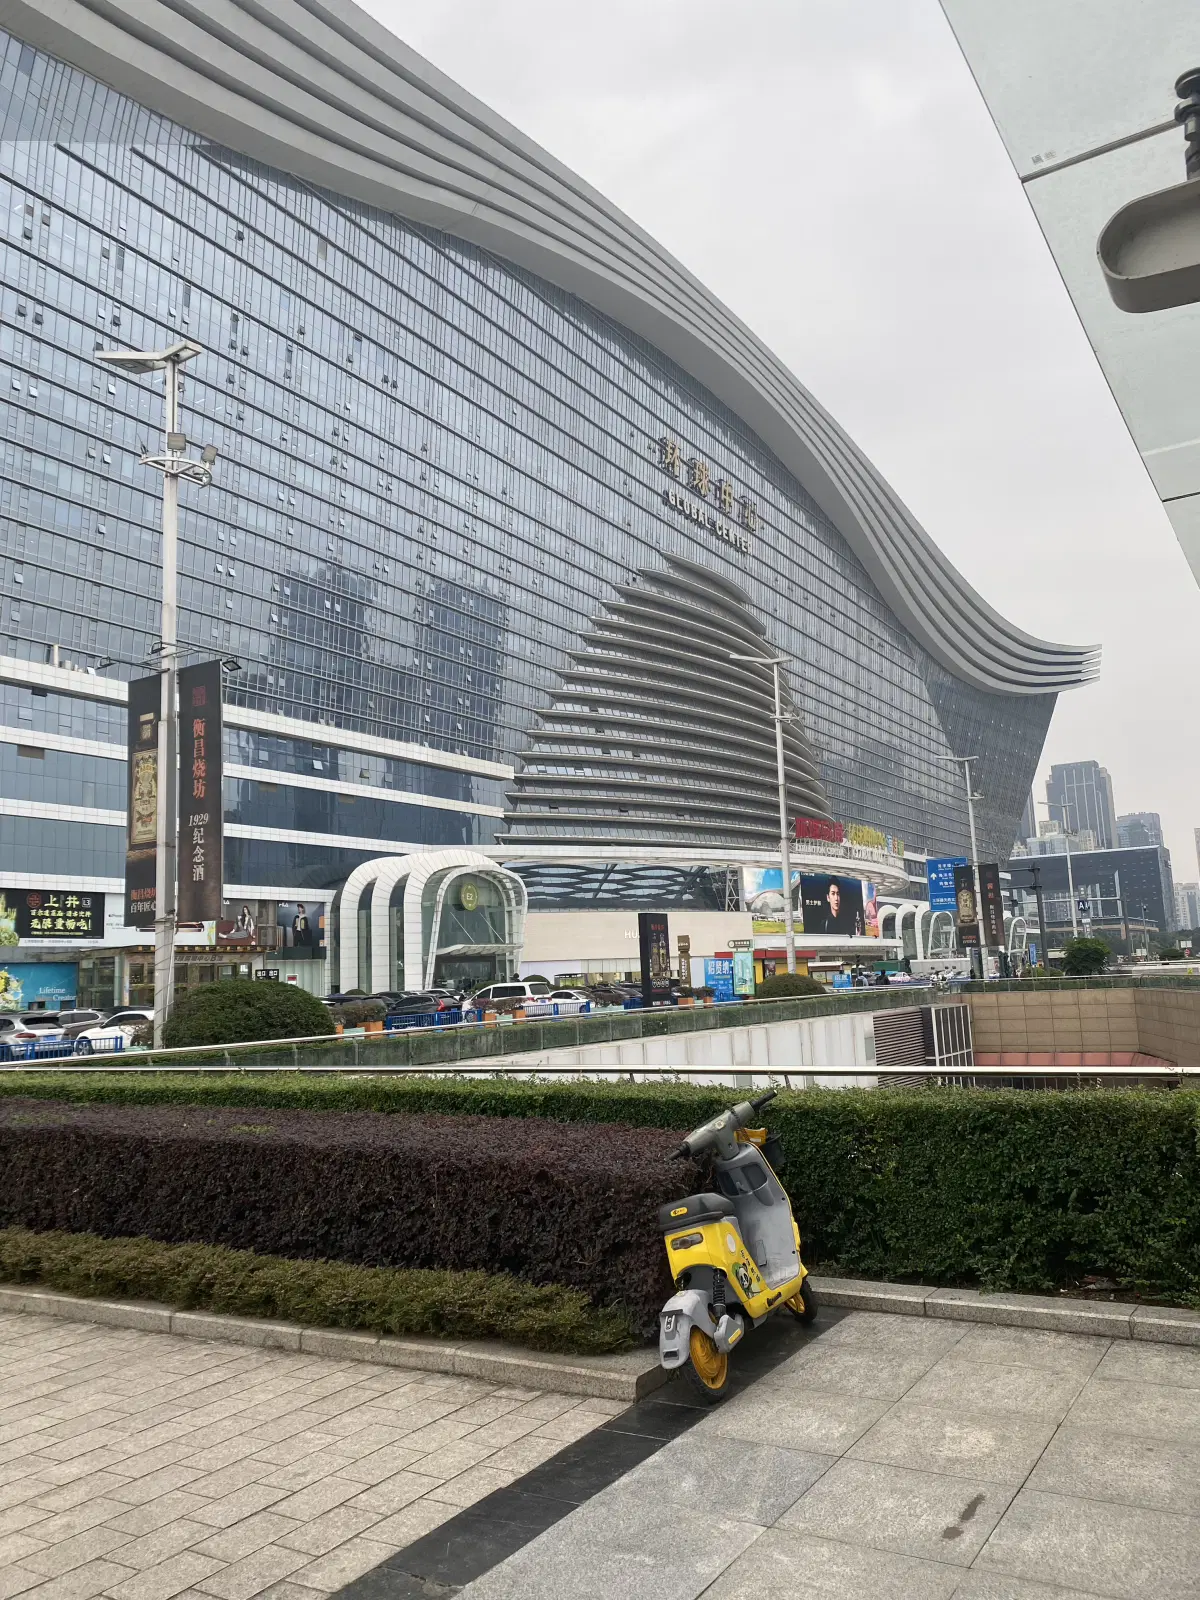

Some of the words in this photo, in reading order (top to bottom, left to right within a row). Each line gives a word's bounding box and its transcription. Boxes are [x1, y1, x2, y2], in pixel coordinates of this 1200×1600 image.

[668, 489, 712, 529] GLOBAL
[715, 520, 753, 555] CENTER
[192, 718, 206, 799] 衡昌烧坊
[188, 812, 210, 827] 1929
[192, 827, 205, 881] 纪念酒
[39, 986, 66, 994] Lifetime
